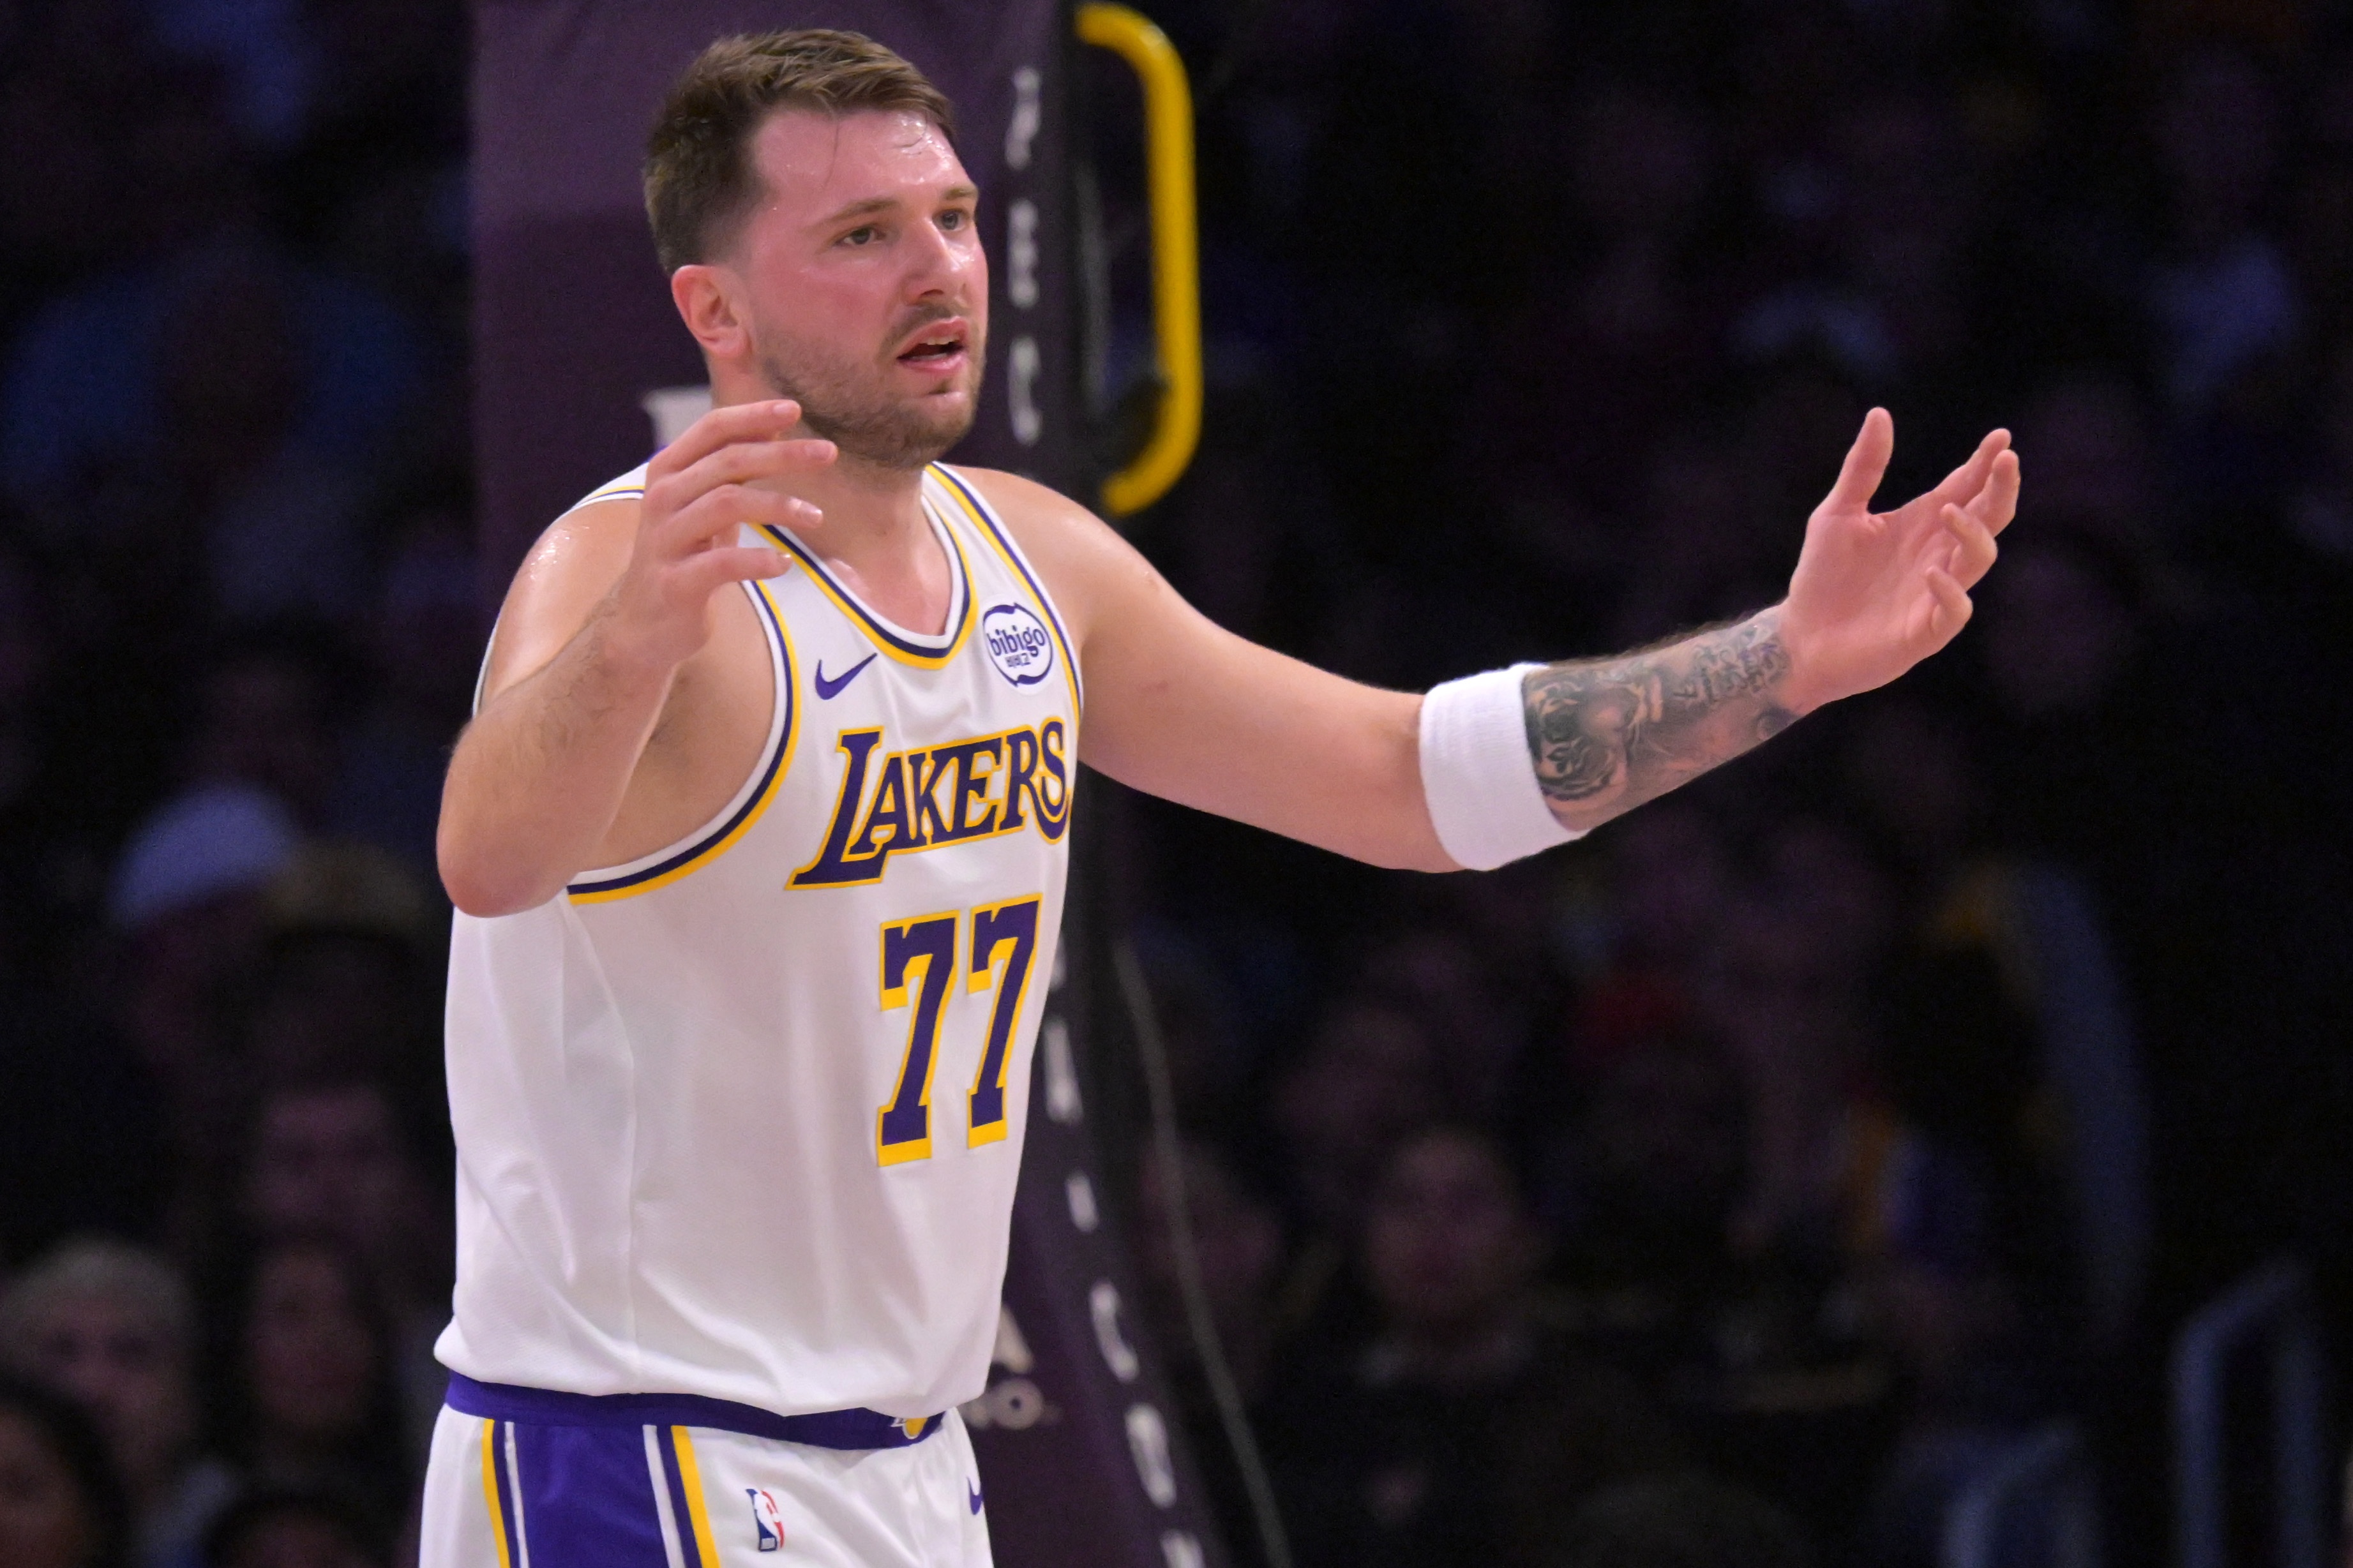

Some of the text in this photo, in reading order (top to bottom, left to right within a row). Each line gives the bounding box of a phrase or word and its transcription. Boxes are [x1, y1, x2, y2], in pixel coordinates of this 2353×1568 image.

[986, 625, 1046, 657] bibigo
[785, 716, 1071, 890] LAKERS
[877, 893, 1043, 1167] 77
